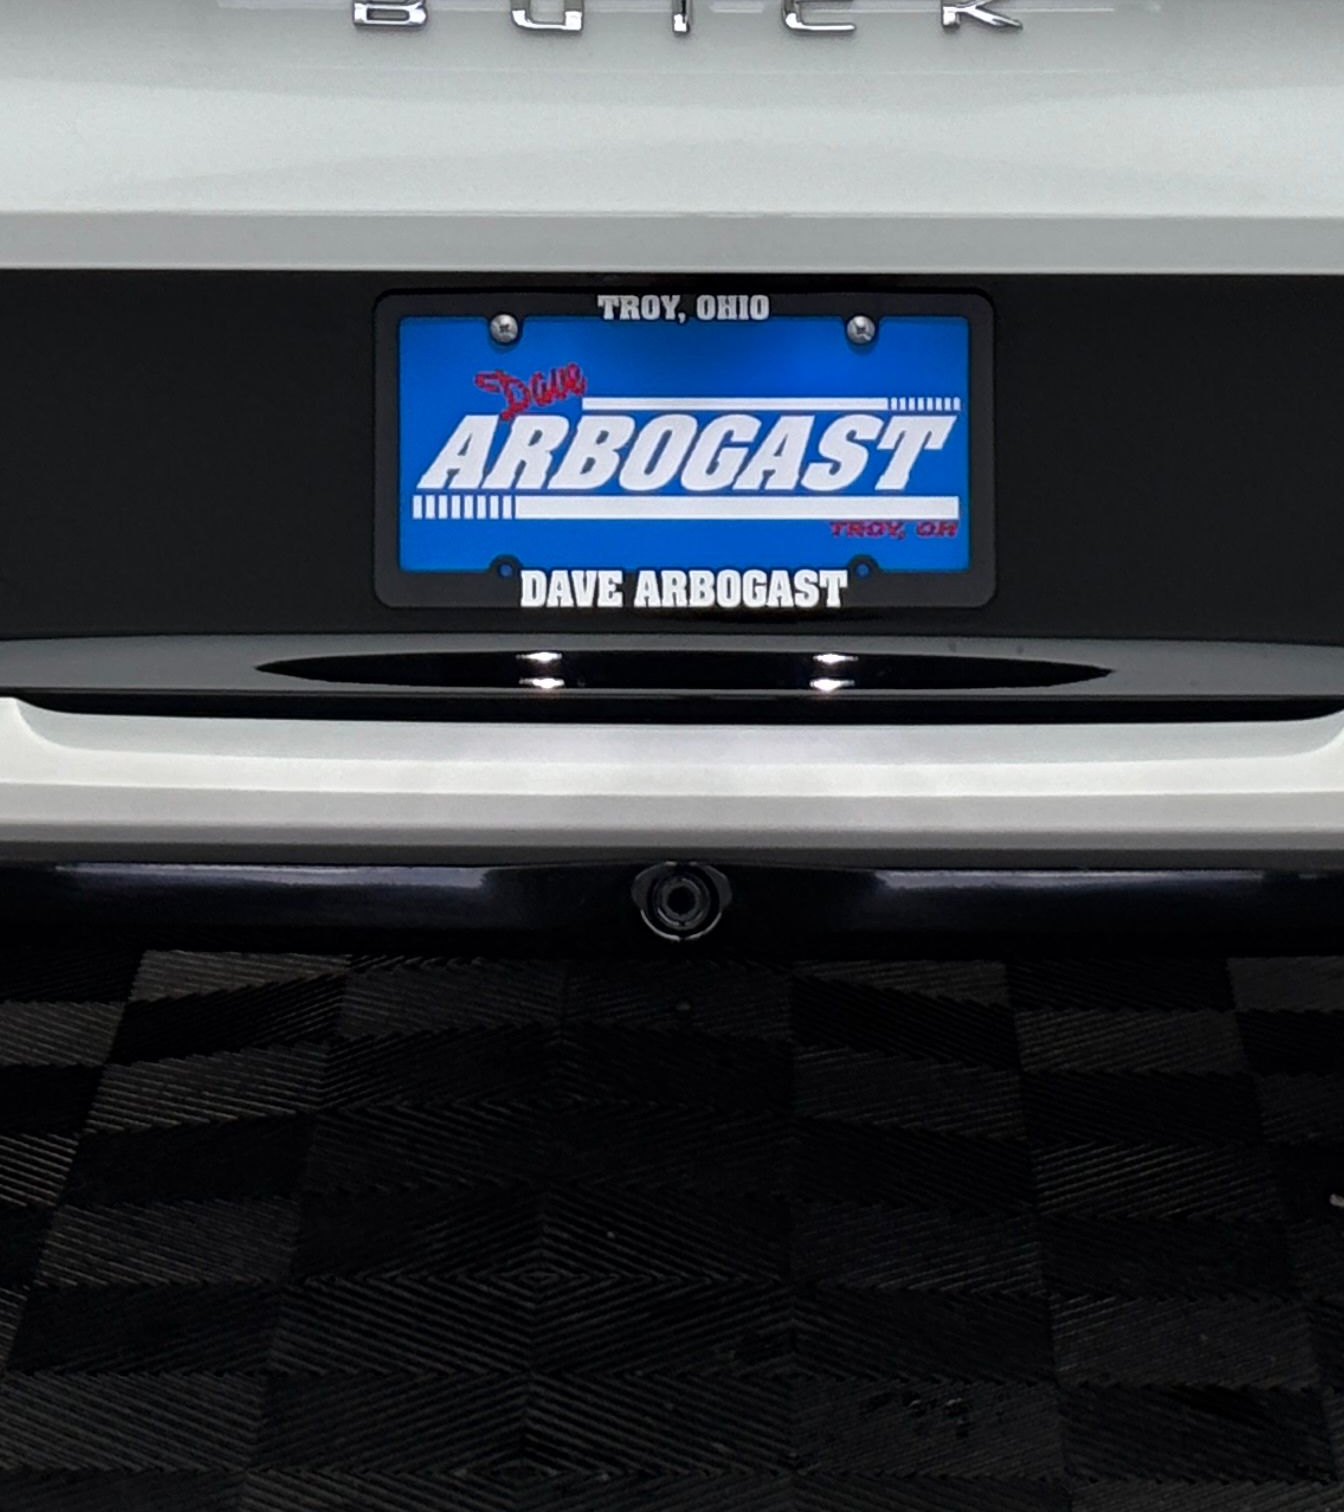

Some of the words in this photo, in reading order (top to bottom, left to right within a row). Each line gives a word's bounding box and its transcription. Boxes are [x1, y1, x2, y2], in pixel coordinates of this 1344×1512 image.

[598, 295, 687, 322] TROY,
[696, 295, 771, 321] OHIO
[475, 362, 587, 420] Dave
[415, 414, 958, 491] ARBOGAST
[830, 521, 905, 540] TROY,
[916, 521, 959, 538] OH
[520, 570, 624, 608] DAVE
[633, 570, 849, 608] ARBOGAST
